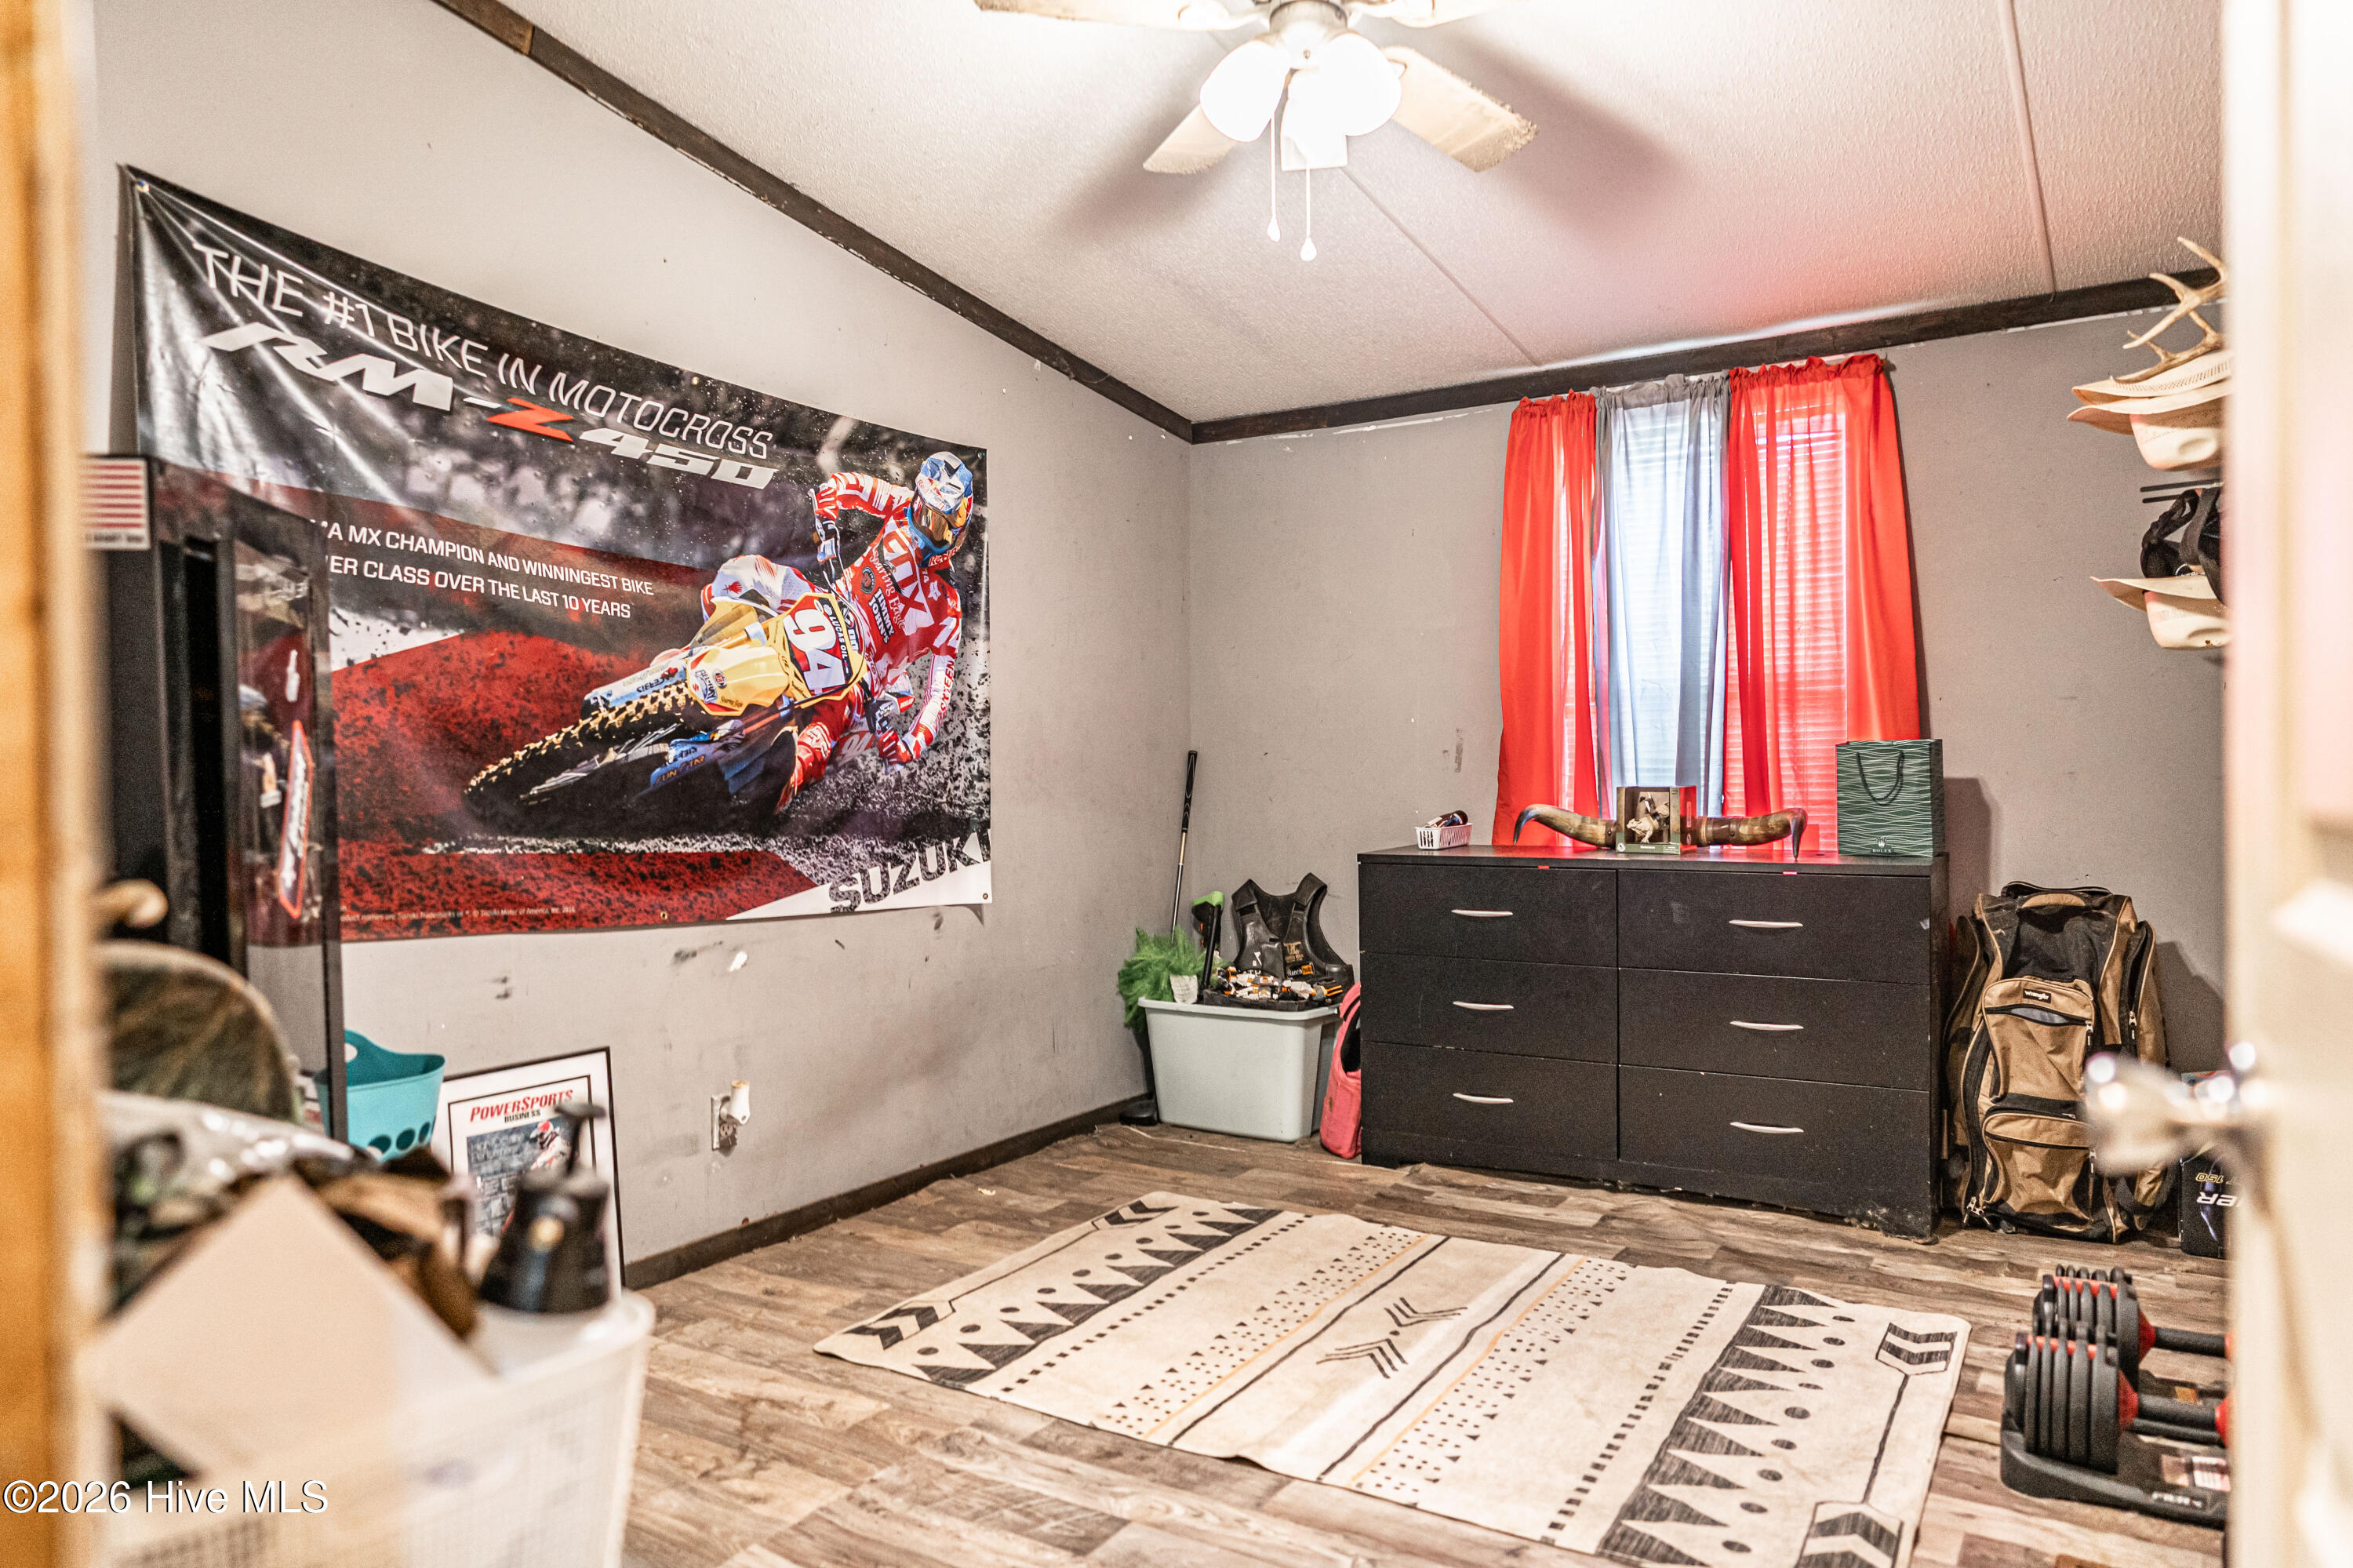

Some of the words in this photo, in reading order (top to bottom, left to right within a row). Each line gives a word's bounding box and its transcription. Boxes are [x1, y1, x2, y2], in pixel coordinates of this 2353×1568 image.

[193, 242, 304, 317] THE
[322, 293, 376, 338] #1
[387, 317, 489, 379] BIKE
[499, 353, 543, 395] IN
[549, 372, 773, 460] MOTOCROSS
[580, 427, 779, 489] 450
[325, 555, 358, 577] ER
[363, 558, 430, 586] CLASS
[435, 570, 485, 594] OVER
[488, 579, 520, 600] THE
[522, 586, 559, 607] LAST
[562, 594, 579, 610] 10
[580, 598, 631, 619] YEARS
[348, 525, 382, 547] MX
[385, 531, 485, 565] CHAMPION
[487, 551, 520, 572] AND
[522, 558, 619, 591] WINNINGEST
[621, 577, 655, 596] BIKE
[830, 616, 845, 646] LUCAS
[868, 597, 889, 644] JOHN'S
[874, 588, 895, 635] JIMMY
[783, 609, 846, 695] 94
[829, 830, 991, 913] SUZUKI
